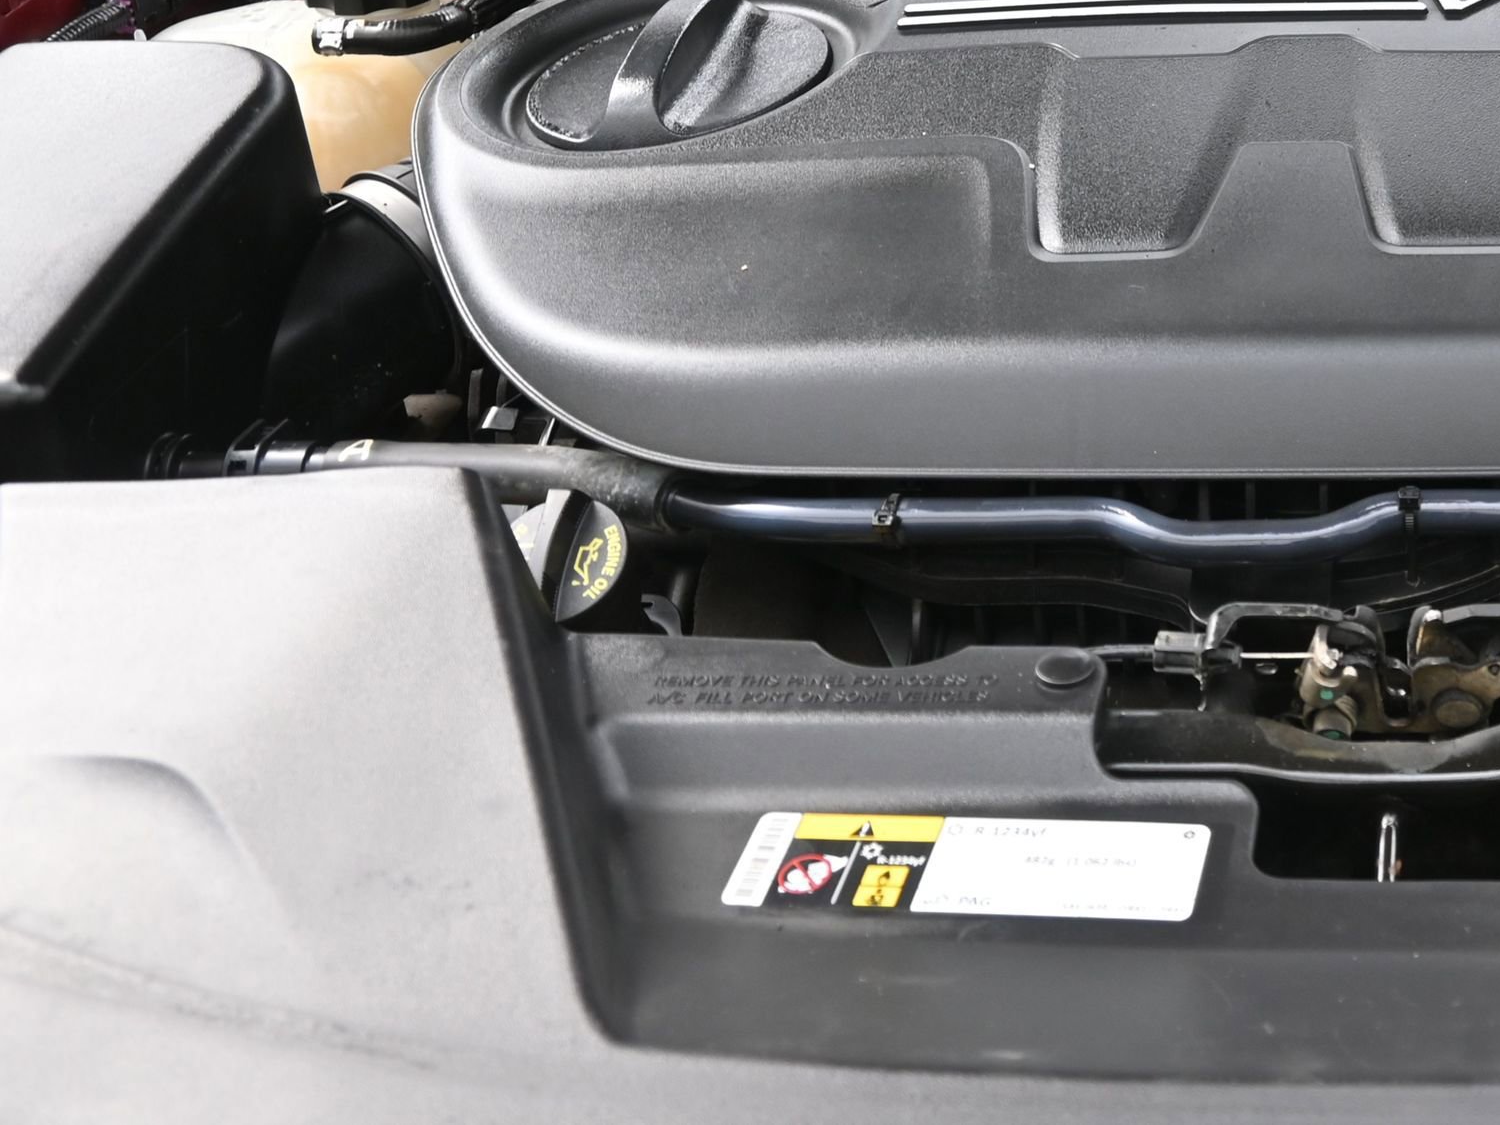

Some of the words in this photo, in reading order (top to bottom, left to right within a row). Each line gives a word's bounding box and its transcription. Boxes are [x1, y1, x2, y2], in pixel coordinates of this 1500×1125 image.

[601, 524, 621, 577] ENGINE
[582, 579, 609, 600] OIL
[653, 674, 735, 688] REMOVE
[739, 674, 782, 688] THIS
[786, 674, 845, 688] PANEL
[851, 674, 890, 687] FOR
[894, 673, 969, 688] ACCESS
[976, 673, 1000, 687] TO
[646, 691, 687, 705] A/C
[695, 691, 734, 705] FILL
[741, 691, 794, 705] PORT
[798, 691, 829, 704] ON
[832, 691, 890, 704] SOME
[896, 690, 991, 705] VEHICLES
